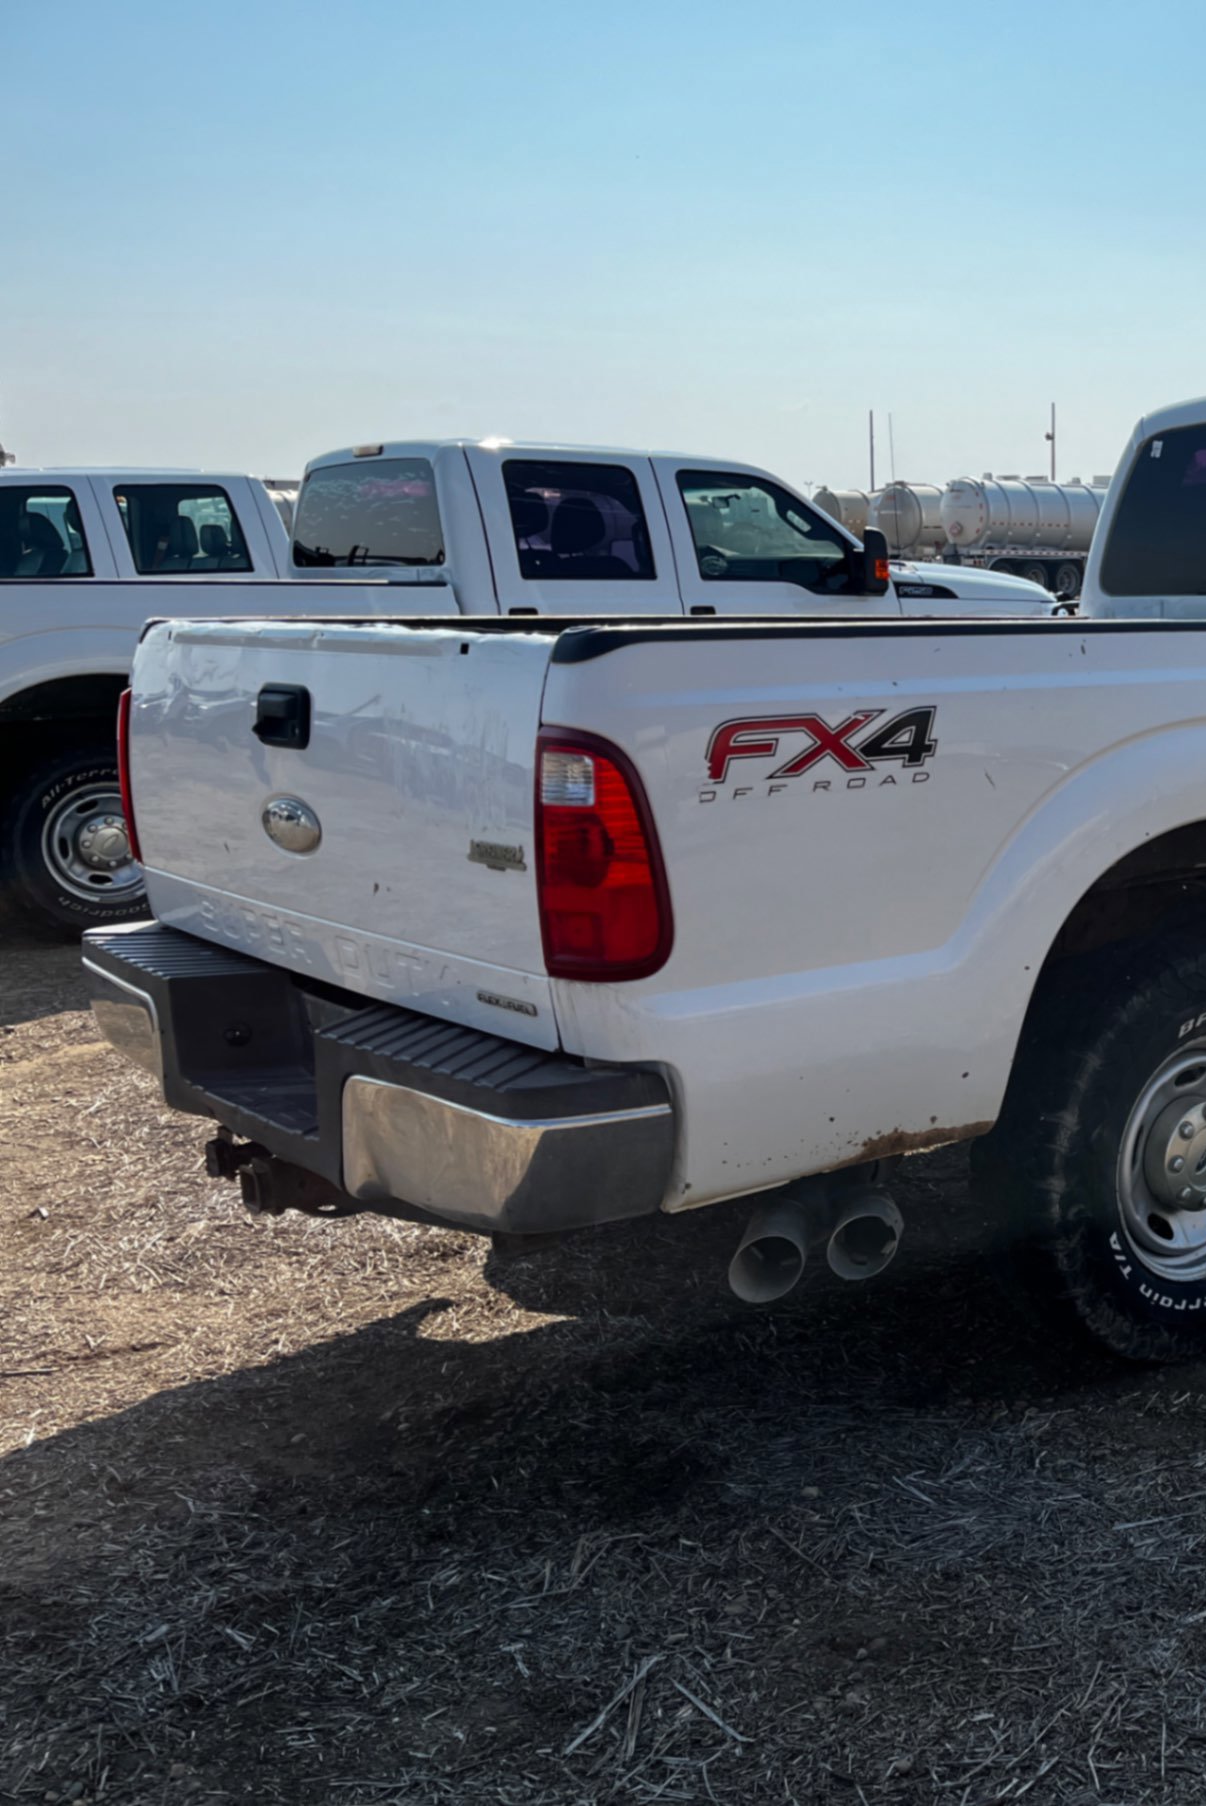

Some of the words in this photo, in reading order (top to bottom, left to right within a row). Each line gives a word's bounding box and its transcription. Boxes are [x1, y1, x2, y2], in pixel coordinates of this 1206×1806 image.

[705, 705, 938, 784] FX4
[698, 783, 788, 804] OFF
[812, 771, 931, 794] ROAD
[198, 894, 314, 965] SUPER
[1109, 1231, 1133, 1281] T/A
